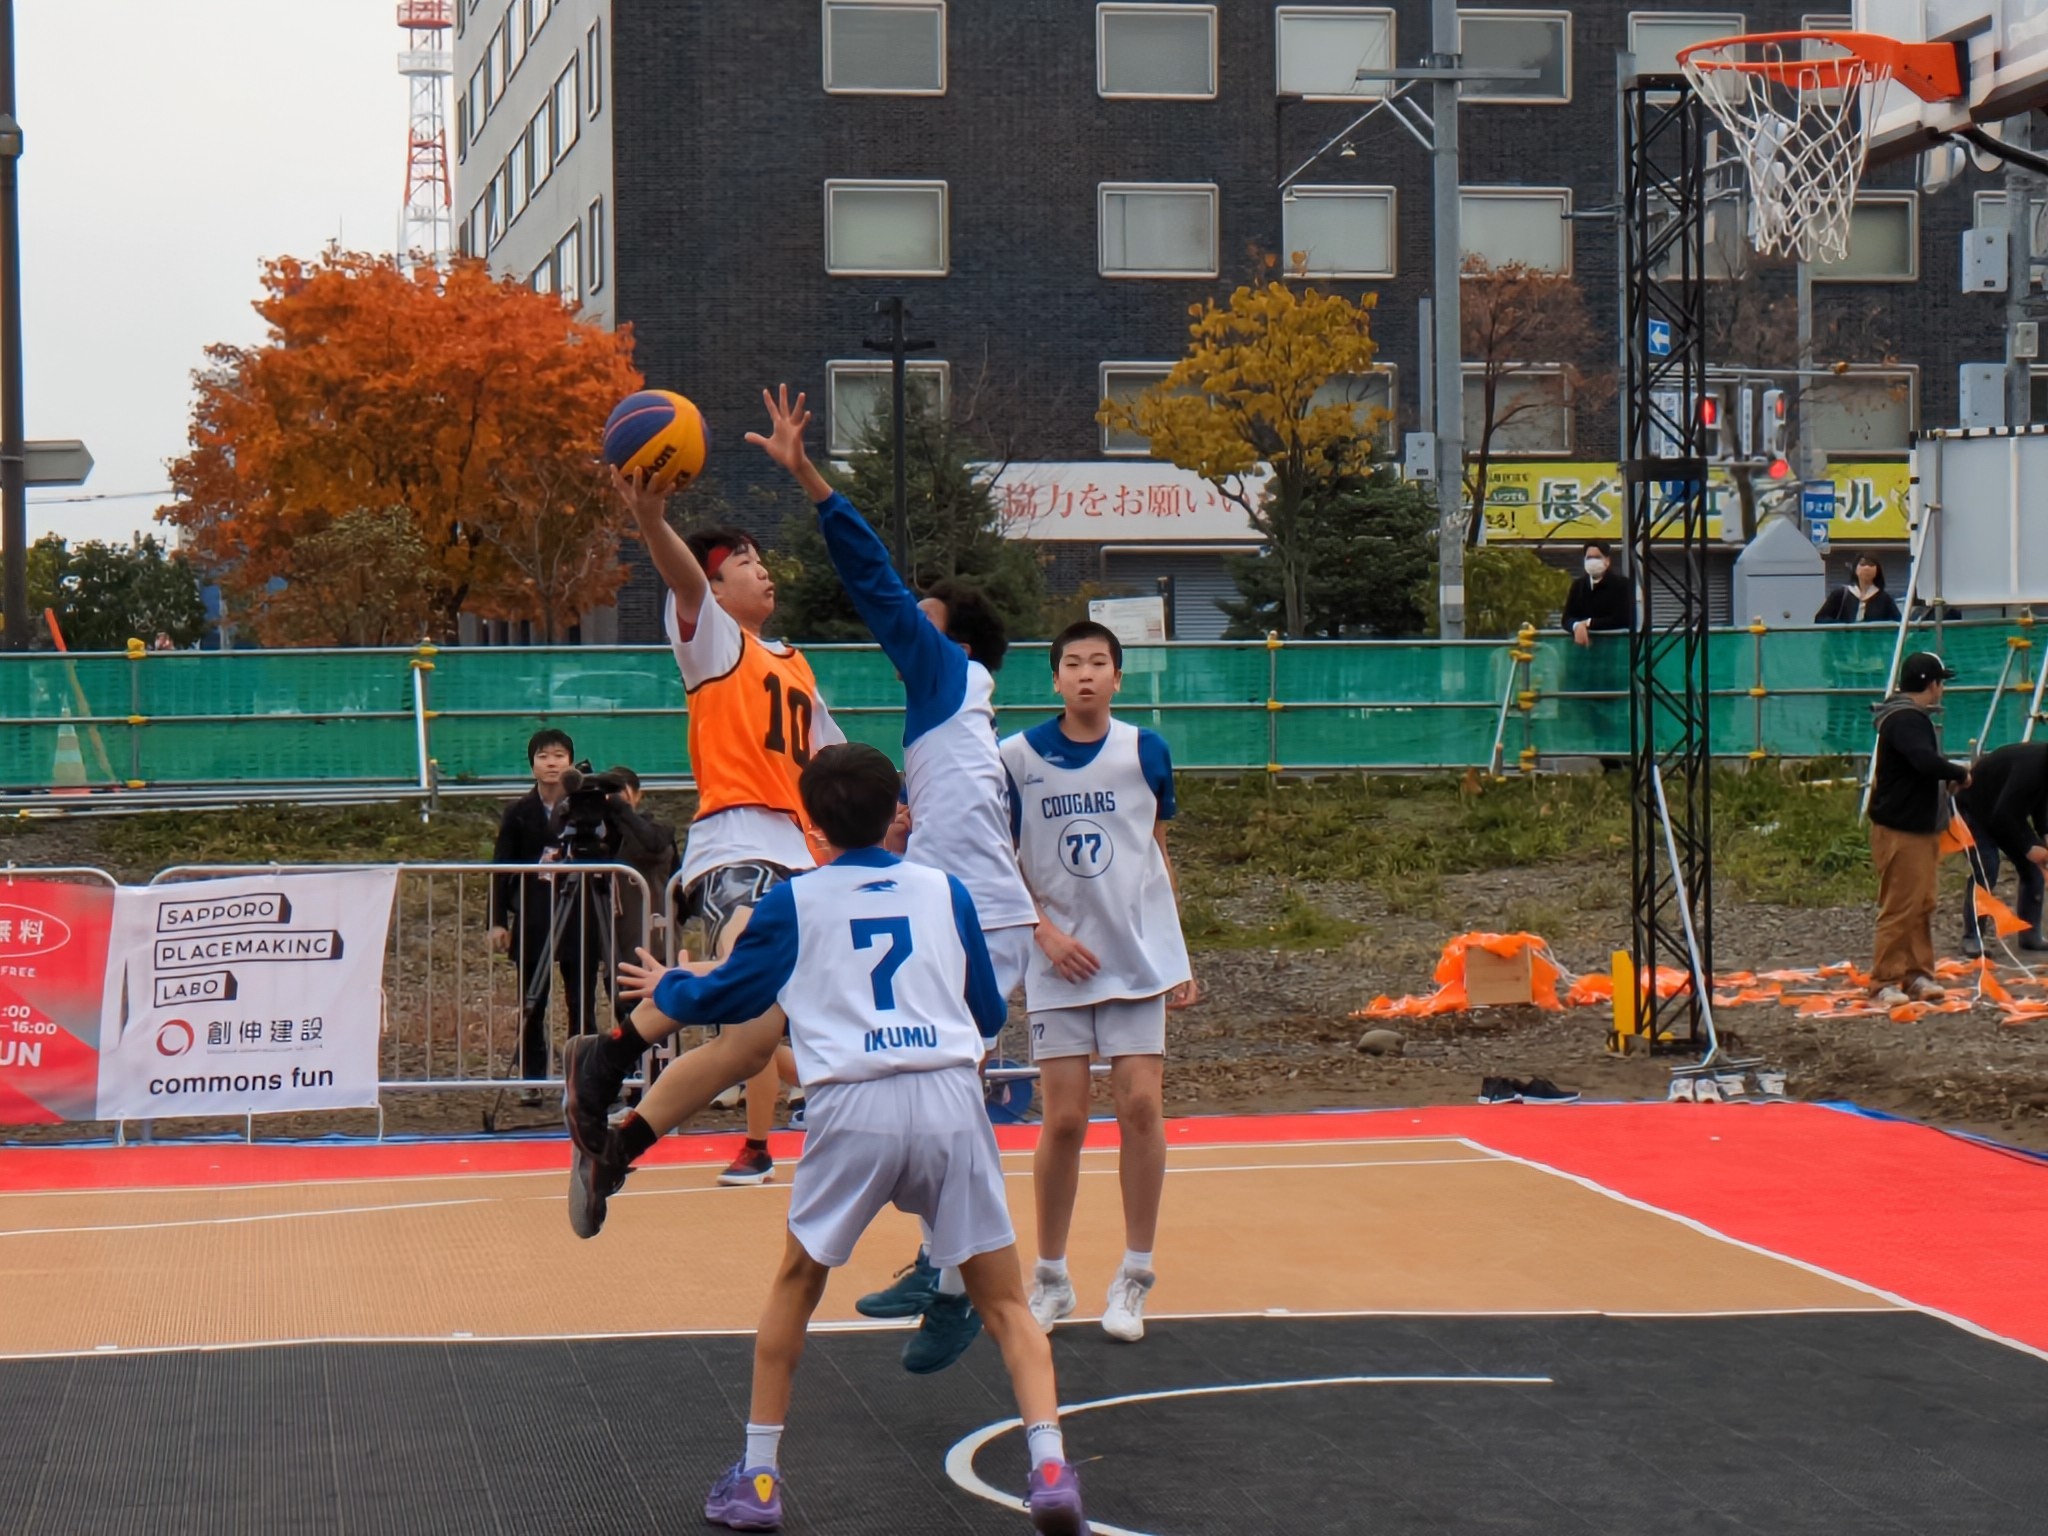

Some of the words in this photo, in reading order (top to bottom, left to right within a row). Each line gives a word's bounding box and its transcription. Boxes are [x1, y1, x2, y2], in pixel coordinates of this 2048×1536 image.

[1003, 482, 1257, 518] 協力をお願いい
[763, 671, 812, 769] 10
[1041, 791, 1116, 819] COUGARS
[1066, 833, 1102, 866] 77
[167, 901, 274, 925] SAPPORO
[1, 965, 36, 978] FREE
[850, 916, 913, 1011] 7
[163, 980, 218, 1000] LABO
[207, 1017, 323, 1045] 創伸建設
[864, 1024, 937, 1053] IKUMU
[149, 1074, 282, 1095] commons
[292, 1067, 334, 1088] fun
